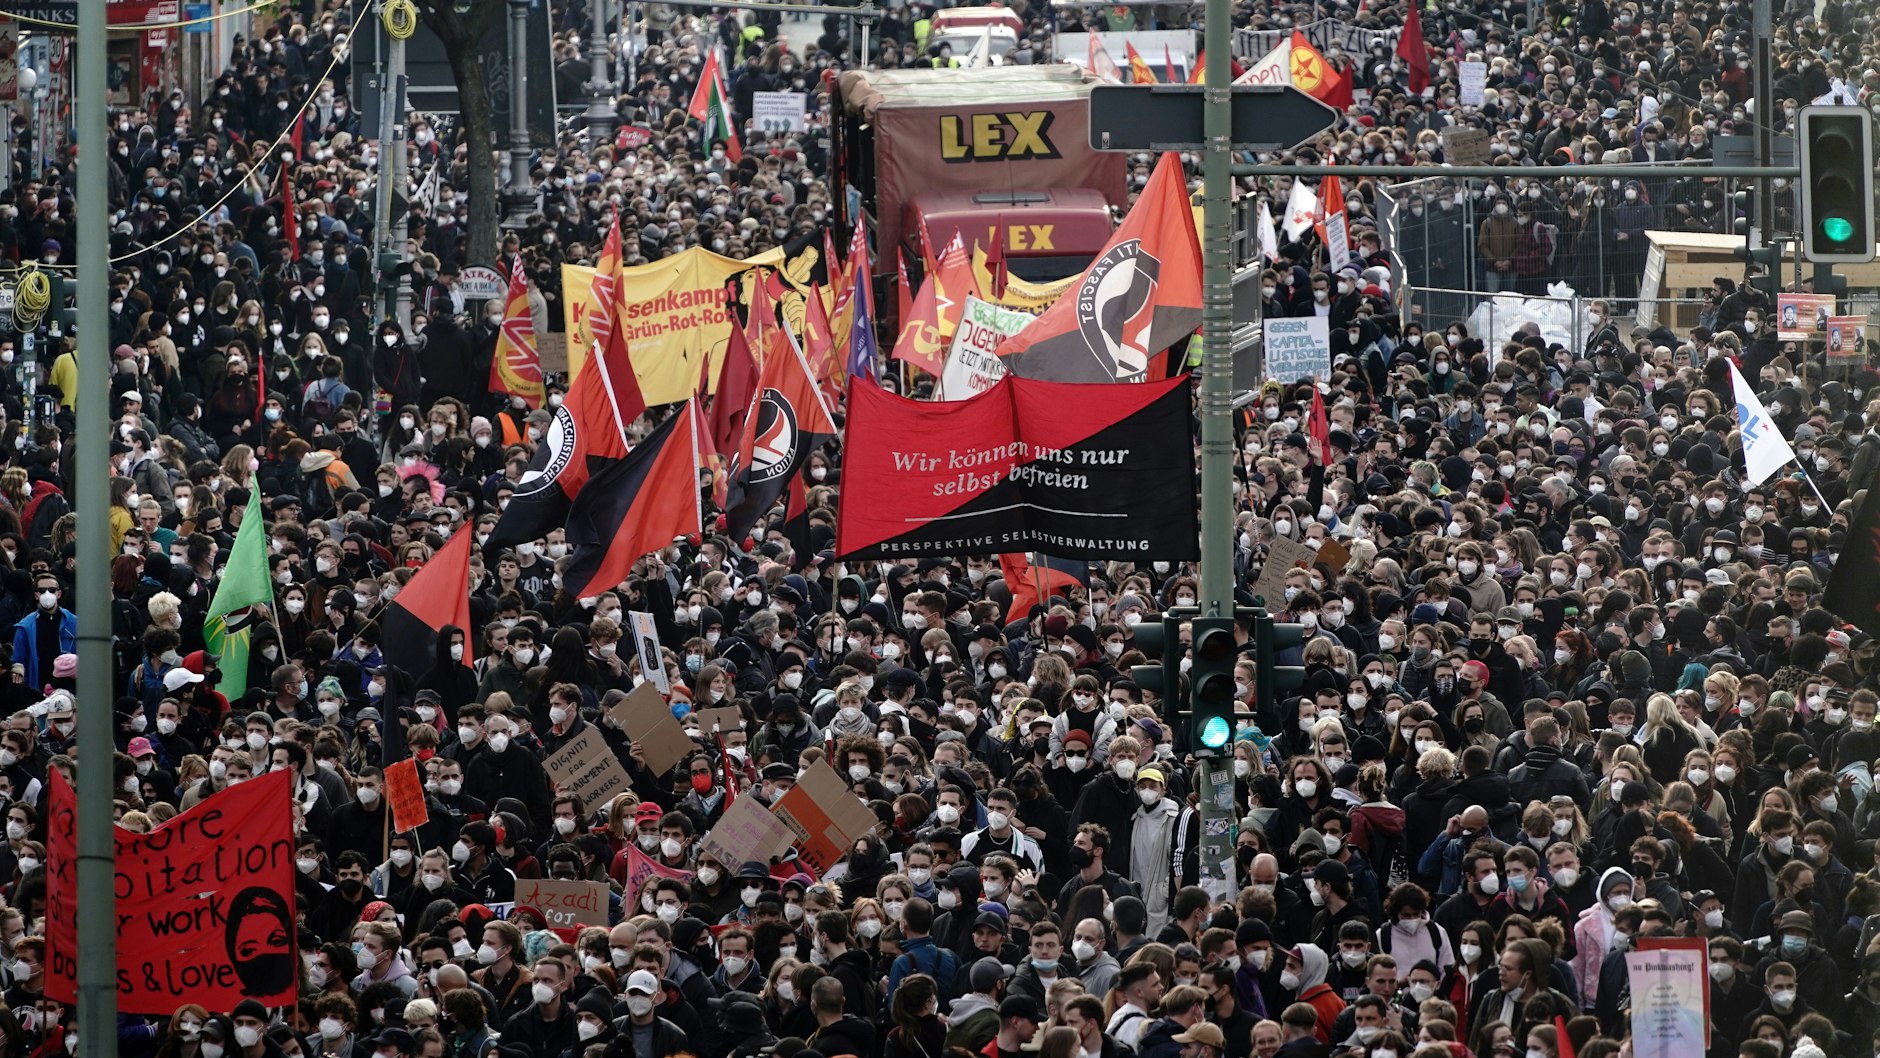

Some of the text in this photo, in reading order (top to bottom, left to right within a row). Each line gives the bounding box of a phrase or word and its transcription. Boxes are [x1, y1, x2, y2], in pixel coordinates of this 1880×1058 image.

[50, 38, 61, 60] 30
[940, 110, 1062, 162] LEX
[1269, 320, 1308, 333] GEGEN
[1269, 335, 1323, 349] KAPITA-
[891, 440, 1130, 472] Wir können uns nur
[933, 463, 1089, 496] selbst befreien
[881, 529, 1150, 552] PERSPEKTIVE SELBSTVERWALTUNG
[550, 738, 588, 772] DIGNITY
[568, 759, 587, 775] FOR
[583, 775, 620, 806] WORKERS
[521, 882, 599, 912] Azadi
[147, 894, 227, 937] work
[545, 908, 576, 925] for
[142, 962, 163, 994] &
[165, 959, 236, 997] love
